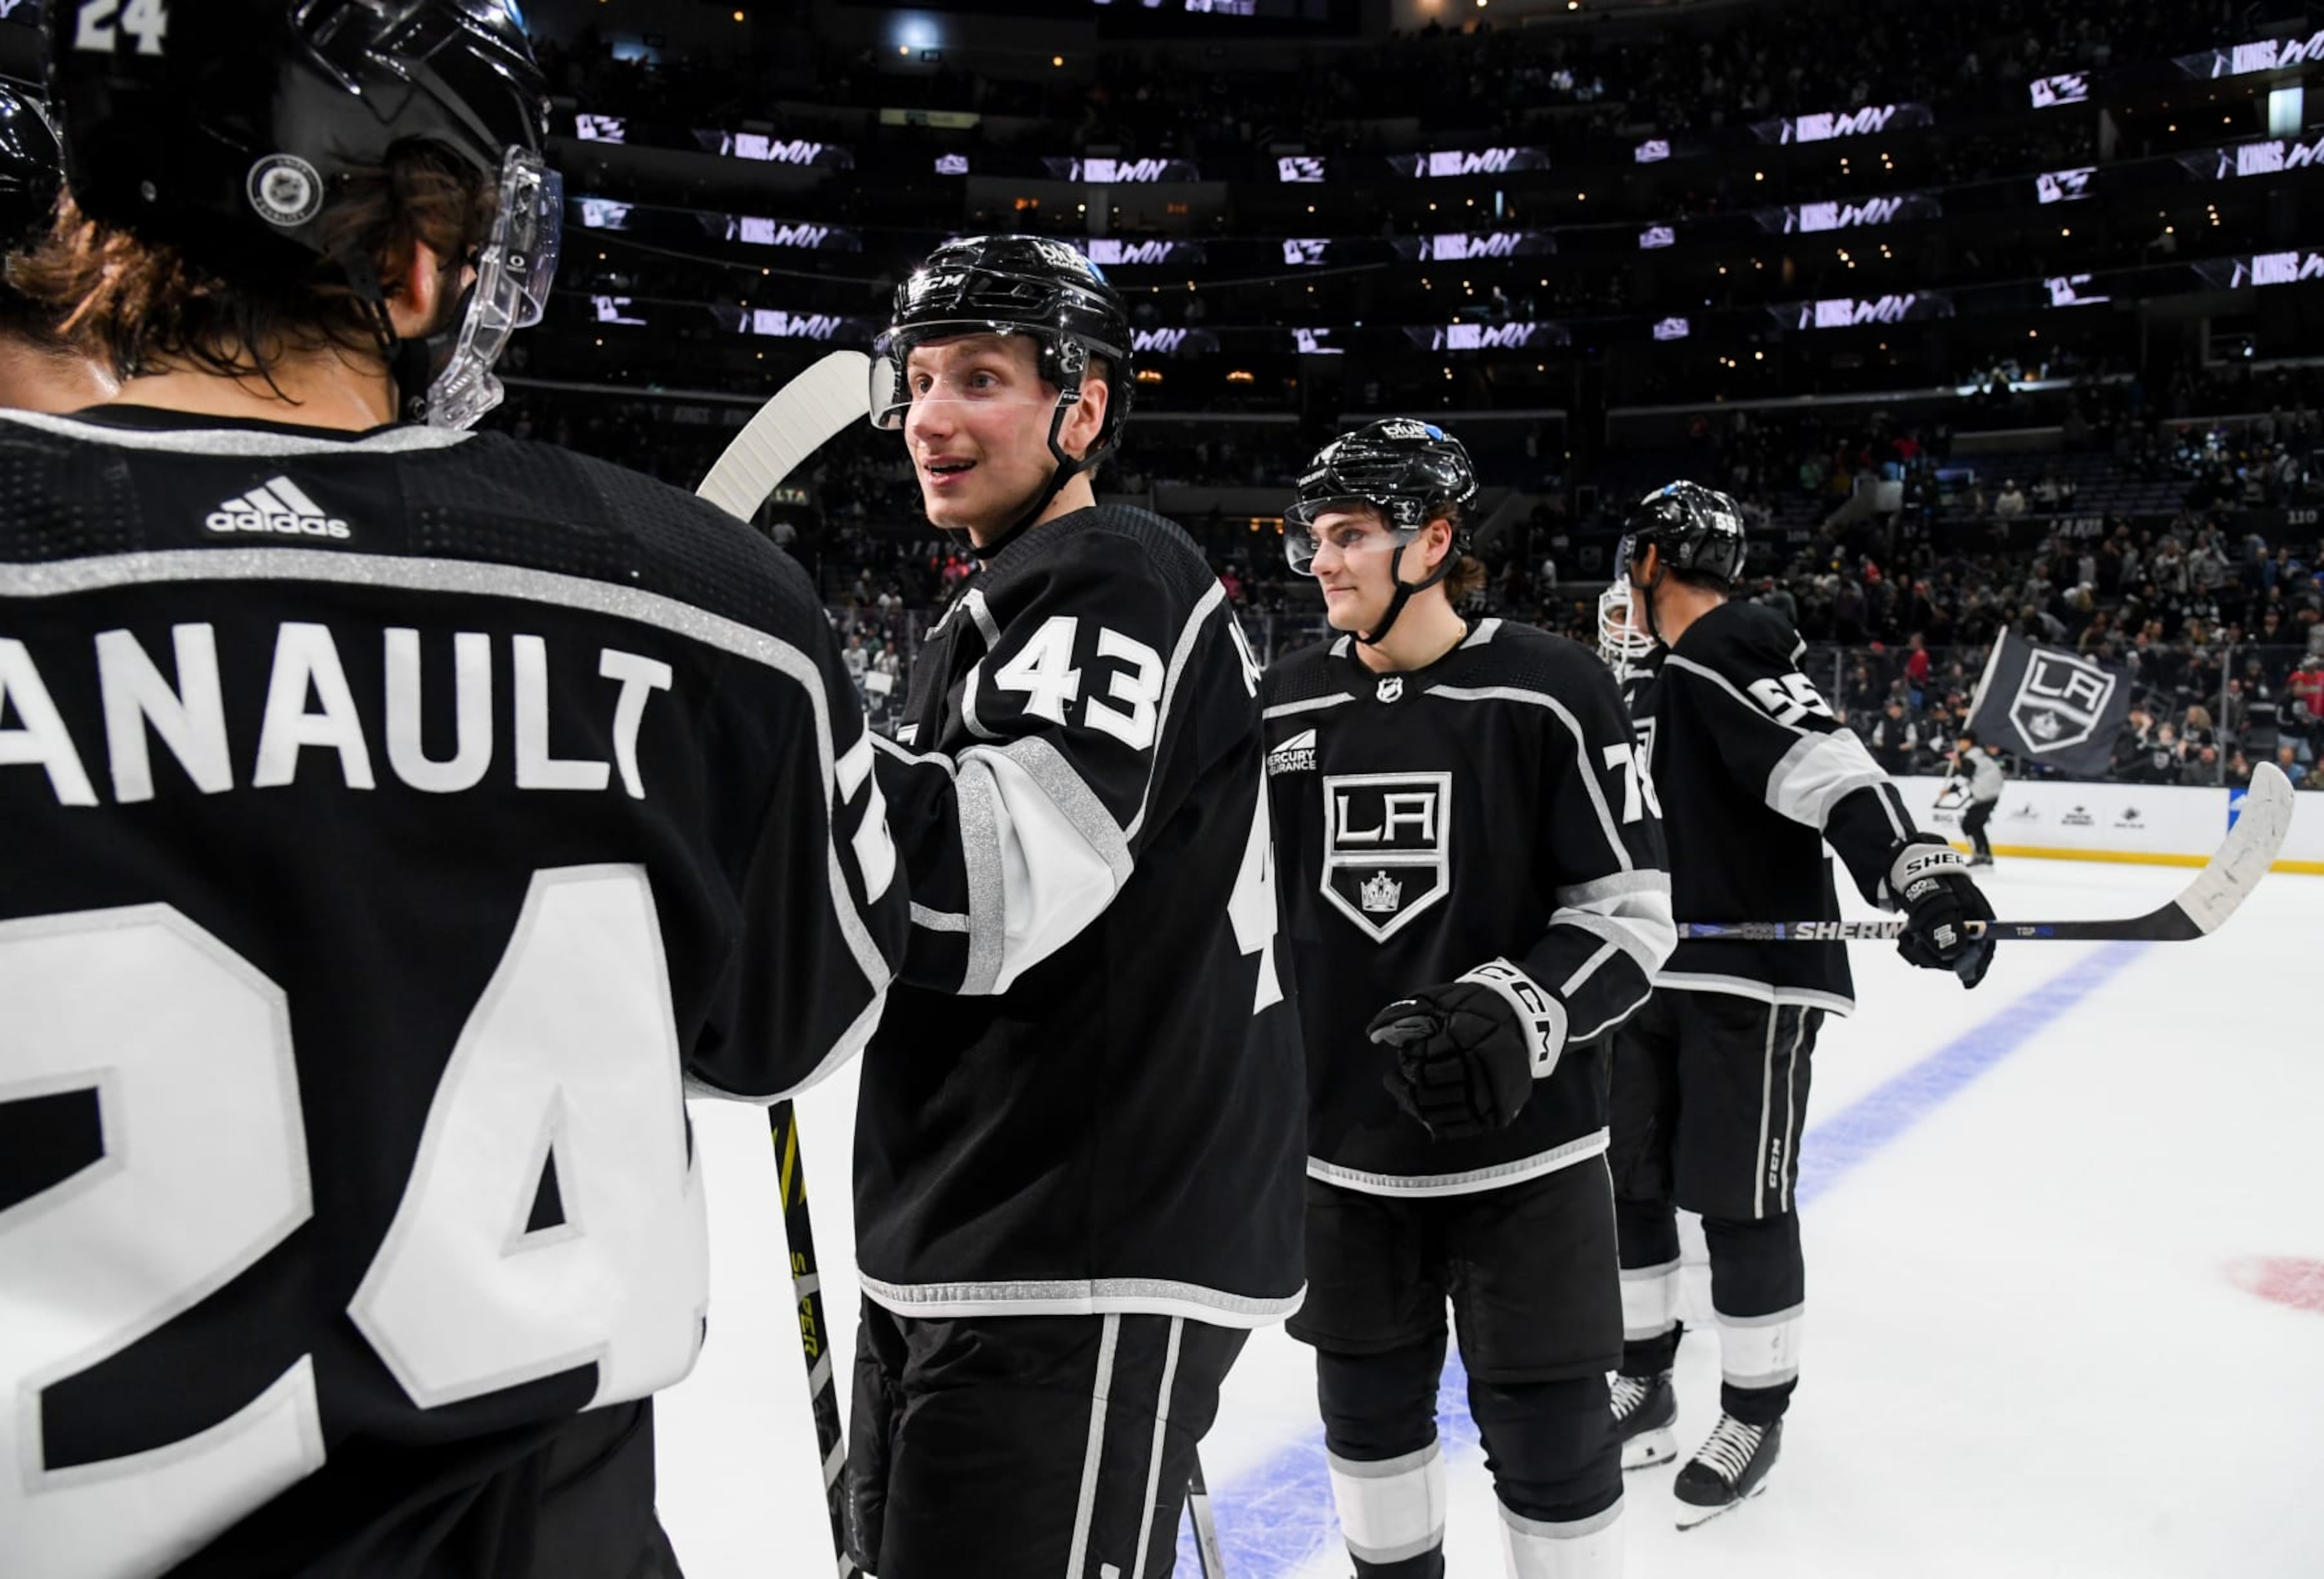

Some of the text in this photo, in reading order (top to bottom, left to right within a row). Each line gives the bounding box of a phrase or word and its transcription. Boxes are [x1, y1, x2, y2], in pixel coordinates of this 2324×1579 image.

[74, 0, 167, 55] 24
[2232, 39, 2278, 74] KINGS
[1833, 104, 1896, 139] WIN
[769, 140, 822, 165] WIN
[1462, 147, 1517, 174] WIN
[2237, 140, 2285, 176] KINGS
[1115, 158, 1168, 183] WIN
[1837, 195, 1903, 229] WIN
[775, 223, 829, 249] WIN
[1121, 240, 1174, 264] WIN
[1466, 232, 1522, 259] WIN
[2251, 251, 2299, 286] KINGS
[1853, 293, 1915, 326] WIN
[787, 314, 842, 341] WIN
[1480, 321, 1537, 350] WIN
[1381, 422, 1427, 436] blue
[206, 511, 351, 539] adidas
[994, 616, 1166, 751] 43
[1746, 671, 1836, 726] 55
[2029, 661, 2105, 711] LA
[0, 622, 673, 807] ANAULT
[1336, 792, 1436, 843] LA
[1471, 965, 1552, 1063] CCM
[1768, 1138, 1781, 1189] CCM
[0, 862, 710, 1579] 24
[790, 1250, 819, 1358] SPER
